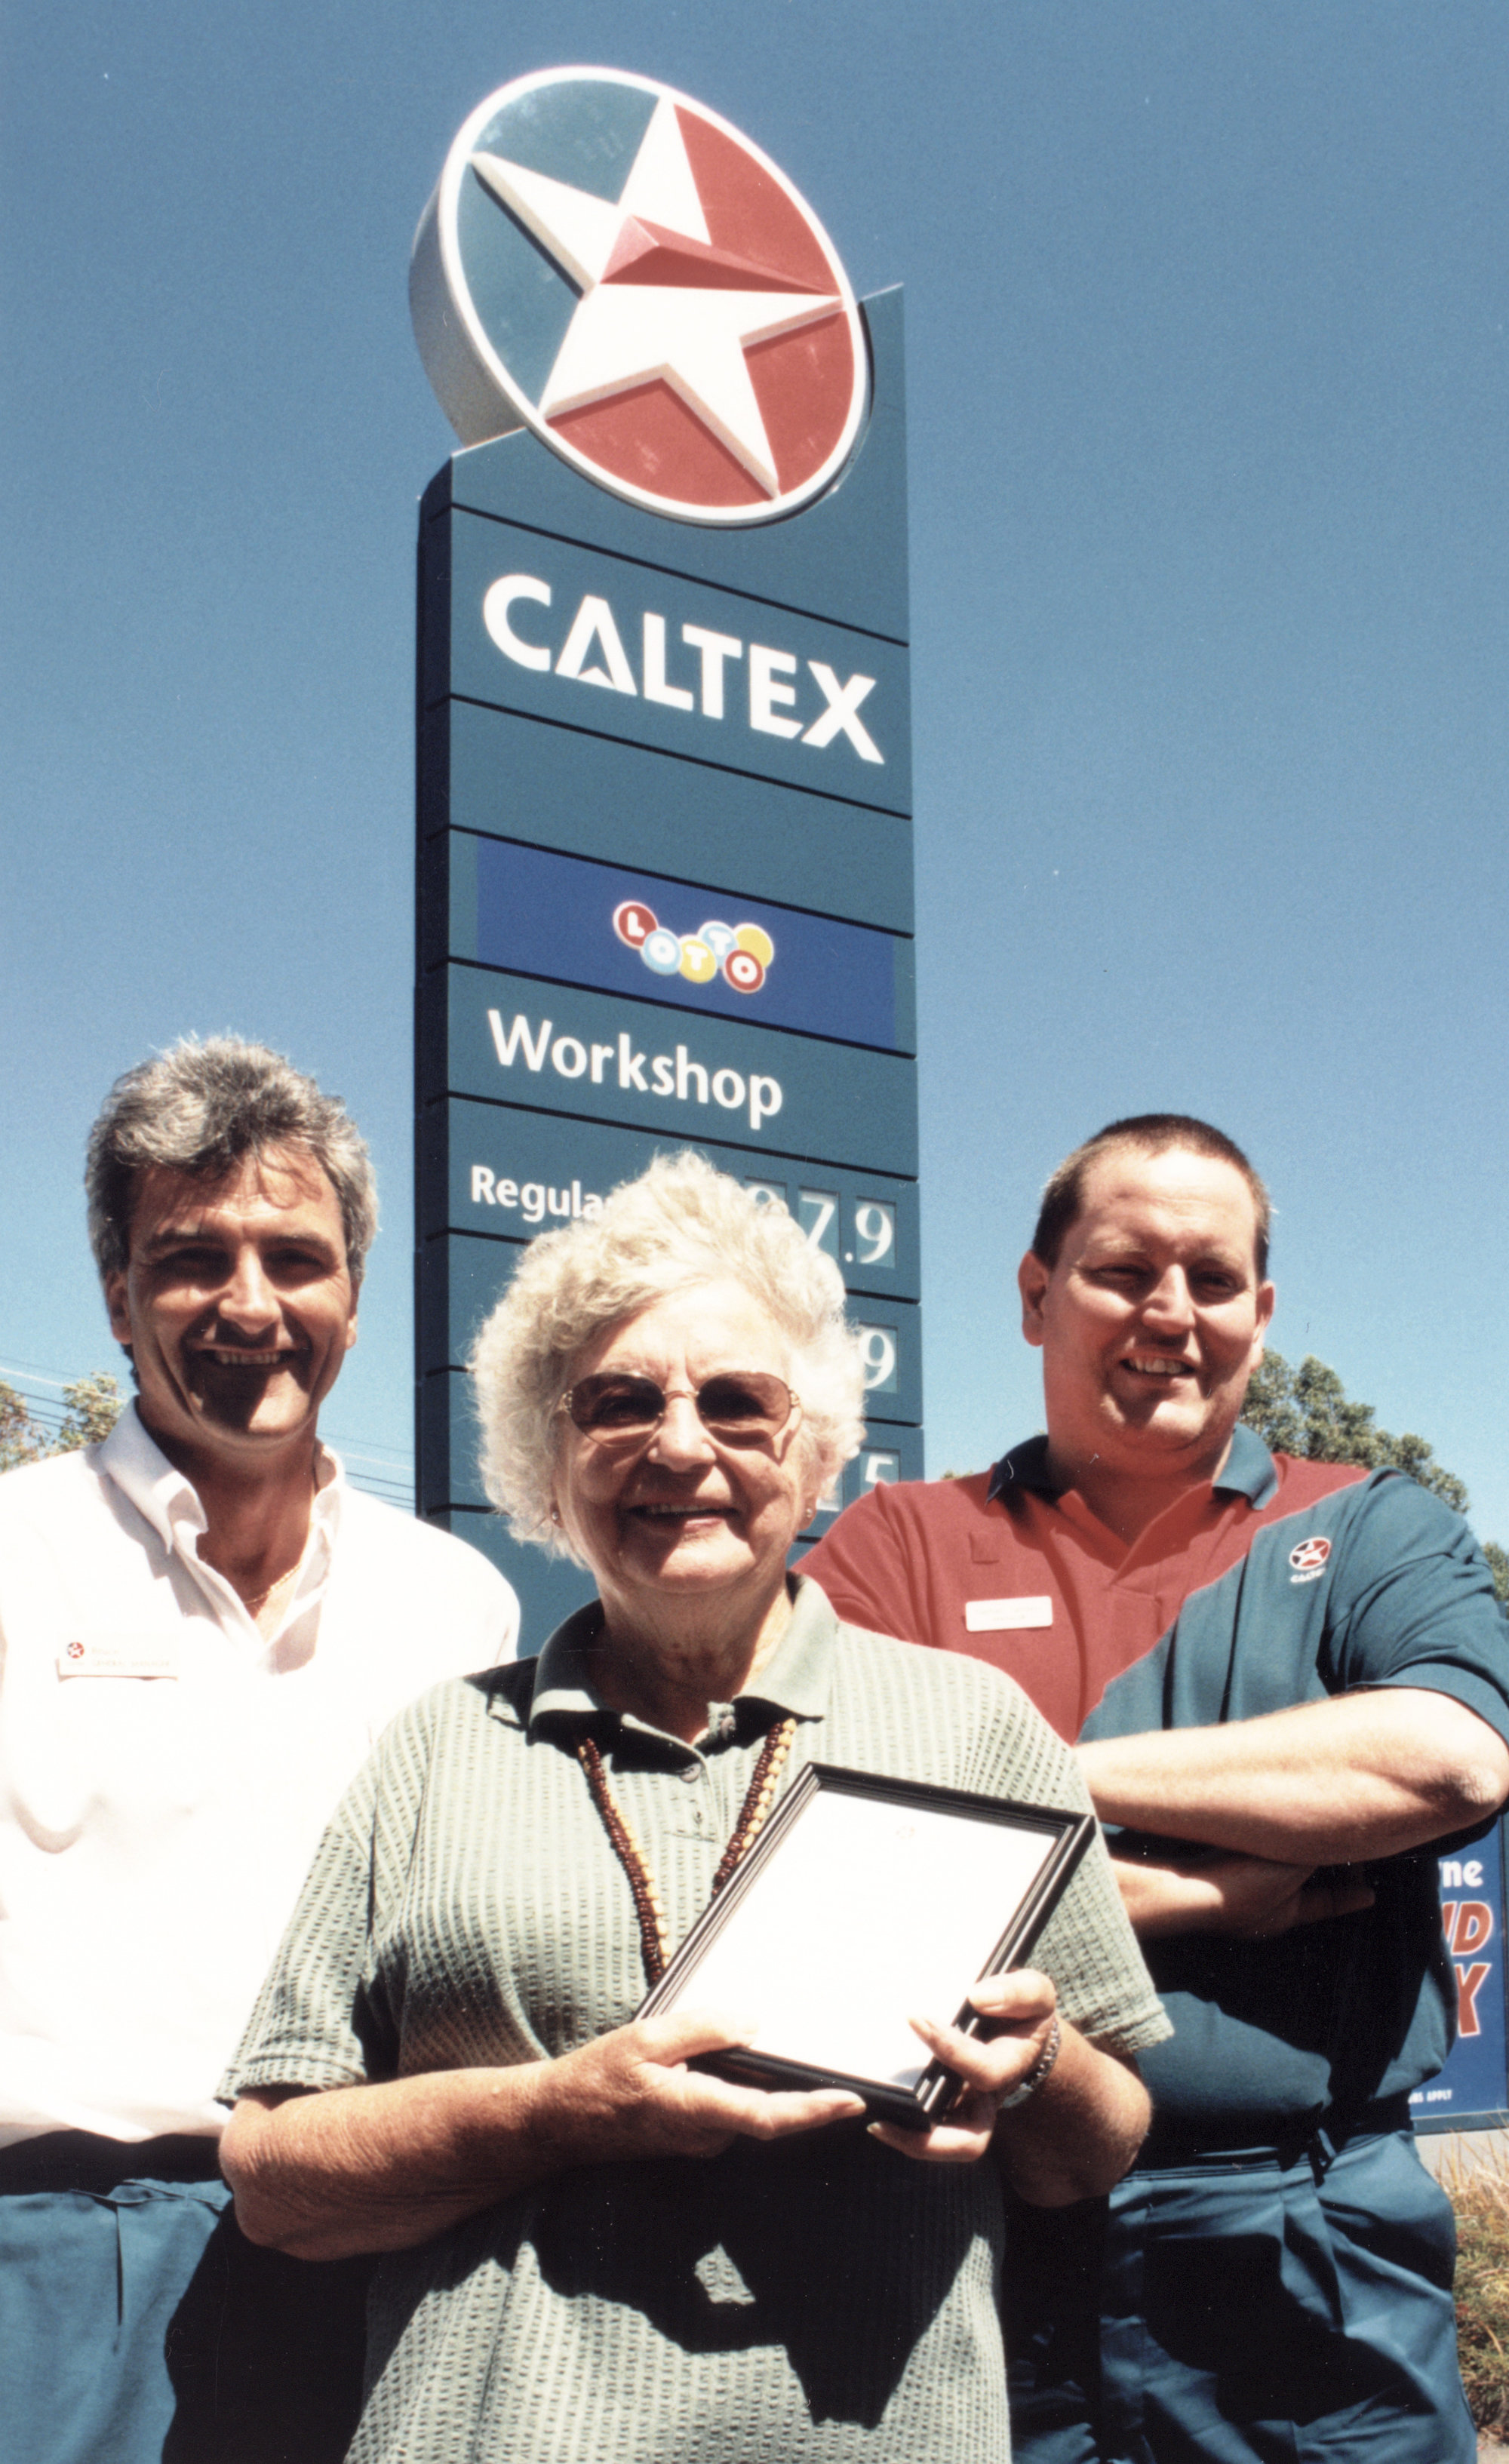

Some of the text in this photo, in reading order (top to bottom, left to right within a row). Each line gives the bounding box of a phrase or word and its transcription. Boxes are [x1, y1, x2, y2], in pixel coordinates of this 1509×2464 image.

[484, 574, 885, 765] CALTEX
[617, 904, 764, 991] LOTTO
[487, 1009, 783, 1131] Workshop
